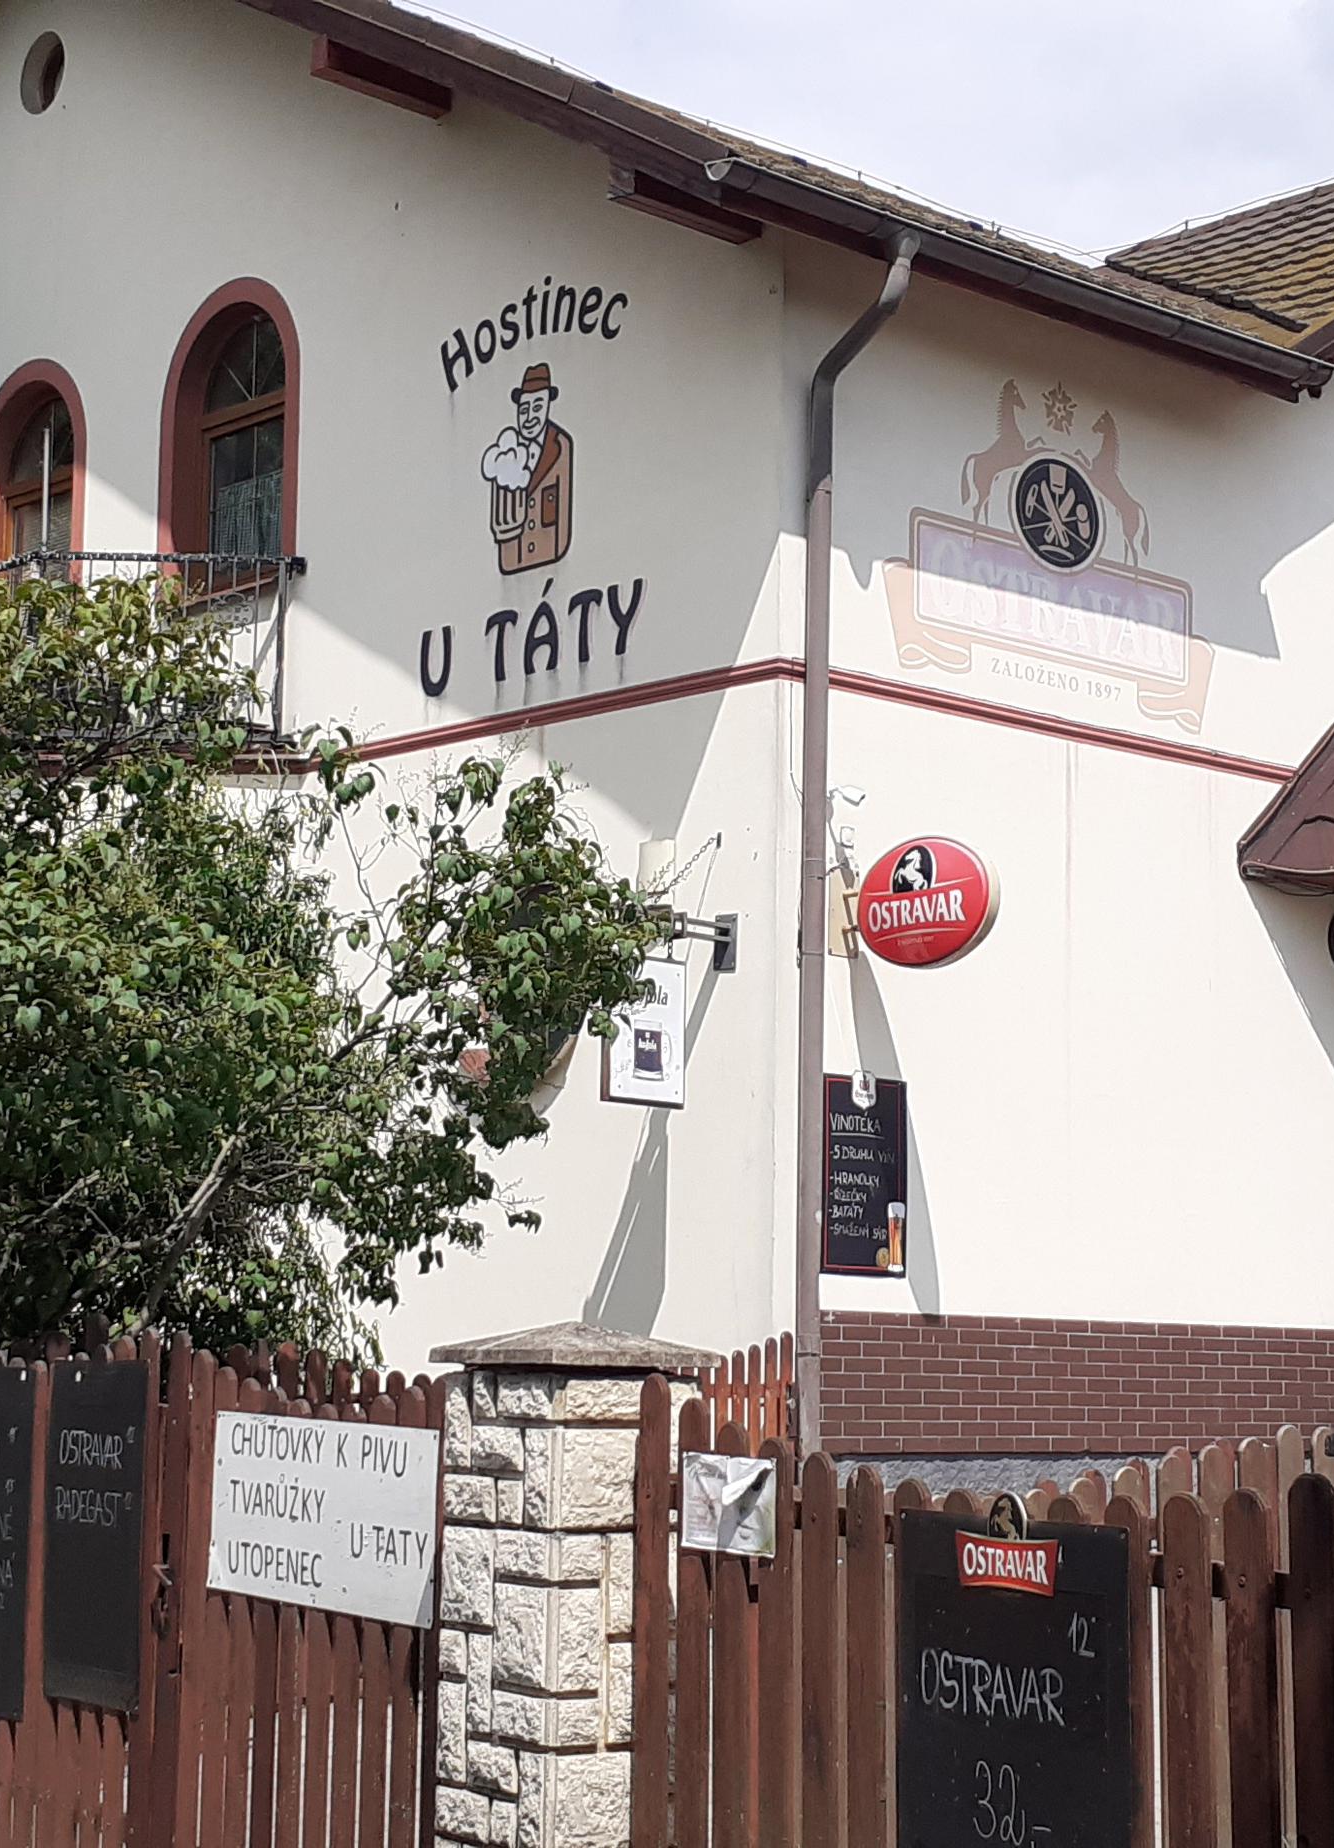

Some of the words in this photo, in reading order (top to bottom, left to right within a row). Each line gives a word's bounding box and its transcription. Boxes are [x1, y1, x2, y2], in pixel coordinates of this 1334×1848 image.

[440, 275, 629, 393] Hostinec
[420, 625, 453, 697] U
[485, 577, 644, 682] TÁTY
[991, 657, 1080, 693] ZALOŽENO
[1087, 680, 1122, 701] 1897
[868, 888, 966, 933] OSTRAVAR
[59, 1429, 123, 1470] OSTRAVAR
[336, 1432, 349, 1468] K
[361, 1434, 408, 1478] PIVU
[55, 1486, 122, 1528] RADEGAST
[230, 1473, 326, 1524] TVARŮŽKY
[351, 1522, 364, 1559] U
[962, 1541, 1050, 1585] OSTRAVAR
[228, 1540, 323, 1588] UTOPENEC
[921, 1648, 1066, 1727] OSTRAVAR
